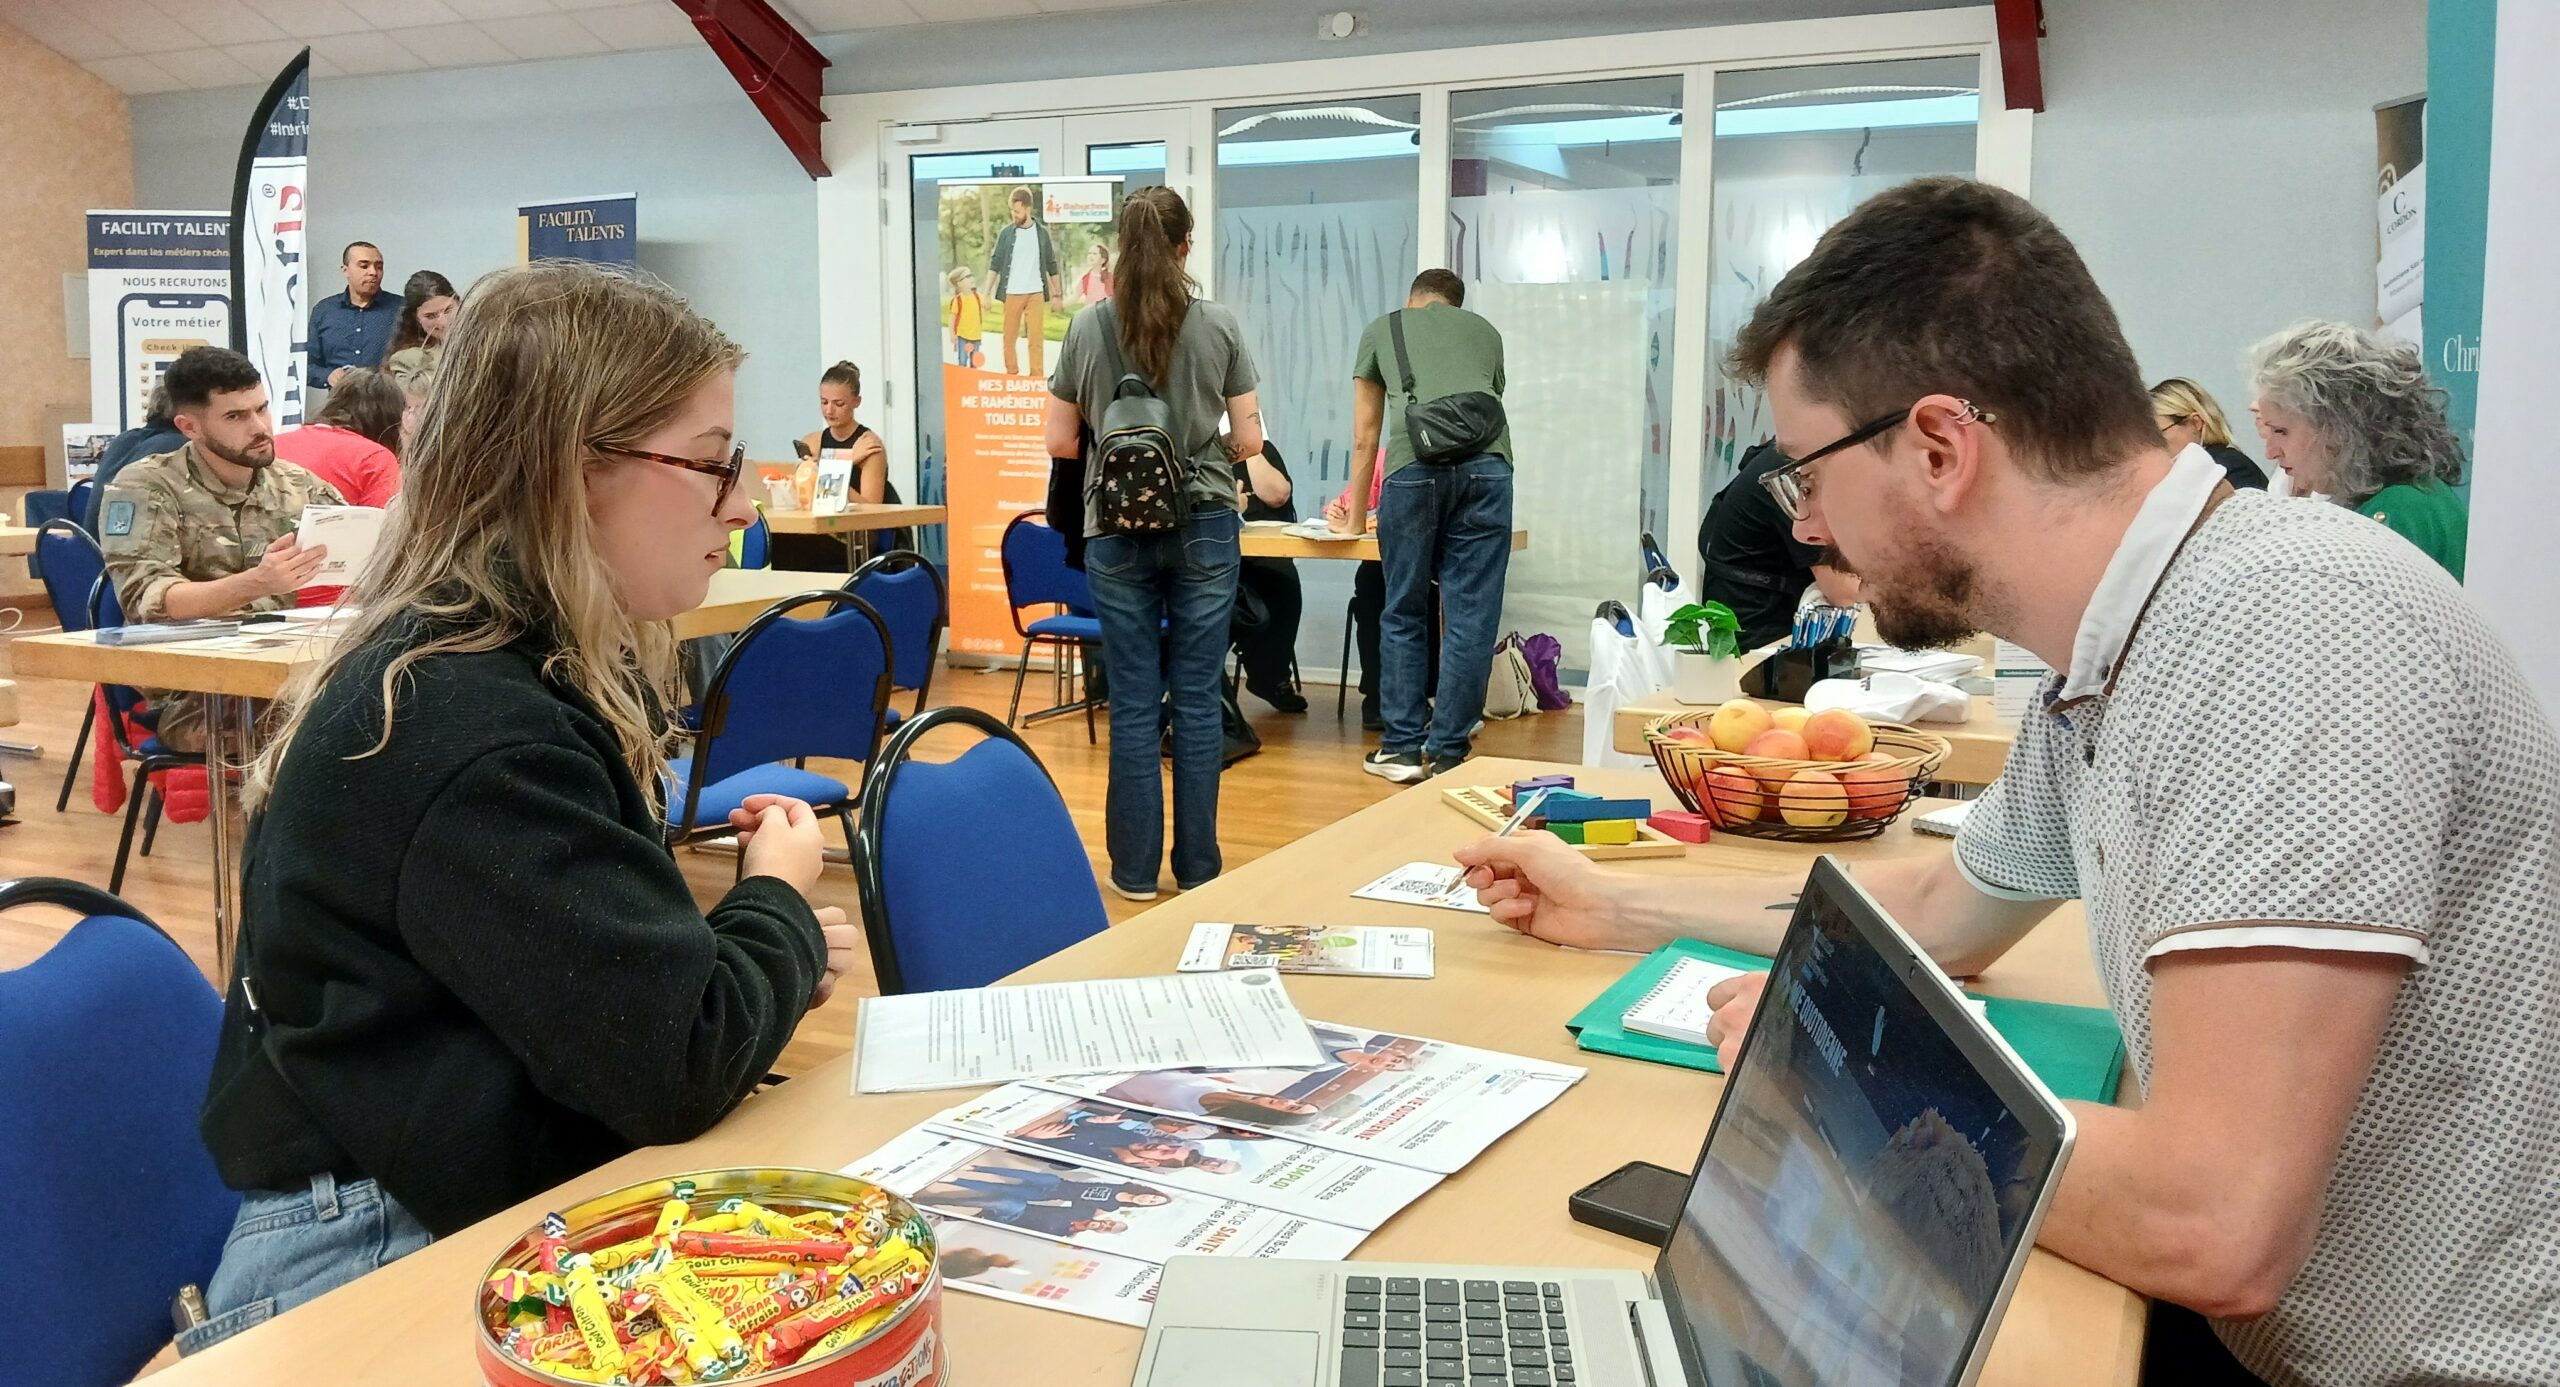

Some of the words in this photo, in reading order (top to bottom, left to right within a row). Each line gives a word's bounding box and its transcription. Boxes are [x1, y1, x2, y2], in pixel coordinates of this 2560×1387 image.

[538, 208, 597, 228] FACILITY
[101, 222, 171, 236] FACILITY
[566, 223, 625, 242] TALENTS
[94, 247, 123, 257] Expert
[125, 247, 148, 256] dans
[165, 248, 201, 257] métiers
[203, 249, 230, 257] techn
[122, 277, 156, 287] NOUS
[159, 278, 228, 287] RECRUTONS
[132, 316, 171, 327] Votre
[175, 317, 221, 328] métier
[146, 341, 177, 351] Check
[2443, 334, 2481, 373] Chri
[978, 379, 1003, 392] MES
[1006, 379, 1048, 393] BABYSI
[961, 395, 979, 408] ME
[984, 413, 1017, 426] TOUS
[1019, 413, 1041, 426] LES
[1269, 1163, 1316, 1190] EMPLOI
[1210, 1209, 1226, 1219] de
[1175, 1218, 1218, 1248] Molsheim
[1280, 1219, 1308, 1240] Jeunes
[1195, 1226, 1238, 1254] SANTÉ
[1264, 1240, 1289, 1254] 16-25
[1115, 1265, 1160, 1299] Molsheim
[575, 1305, 596, 1331] Citron
[747, 1306, 780, 1330] Fraise
